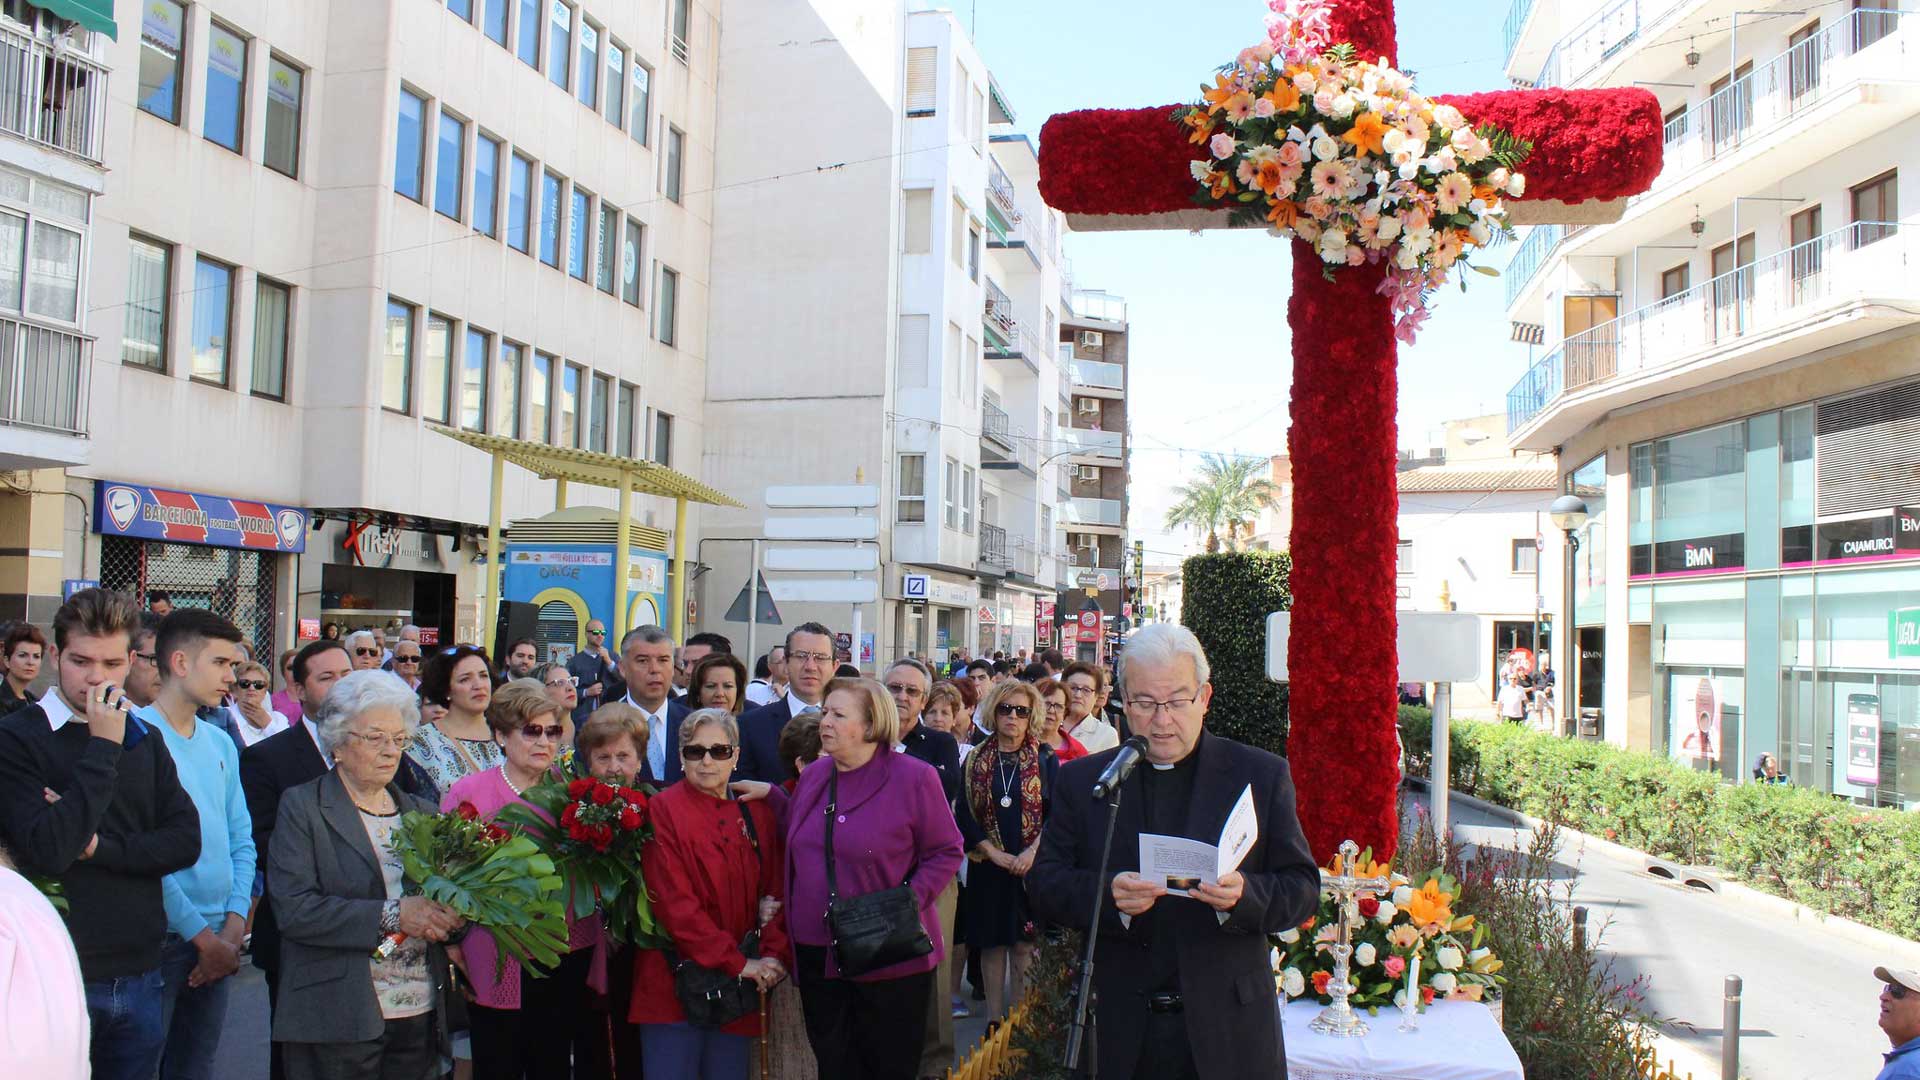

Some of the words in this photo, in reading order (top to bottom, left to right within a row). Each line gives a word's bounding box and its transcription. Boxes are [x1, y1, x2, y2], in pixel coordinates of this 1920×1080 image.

[143, 503, 208, 528] BARCELONA
[210, 519, 239, 532] FOOTBALL
[240, 516, 275, 534] WORLD
[1844, 537, 1893, 554] CAJAMURCI
[1685, 546, 1713, 567] BMN
[539, 565, 581, 580] ONCE
